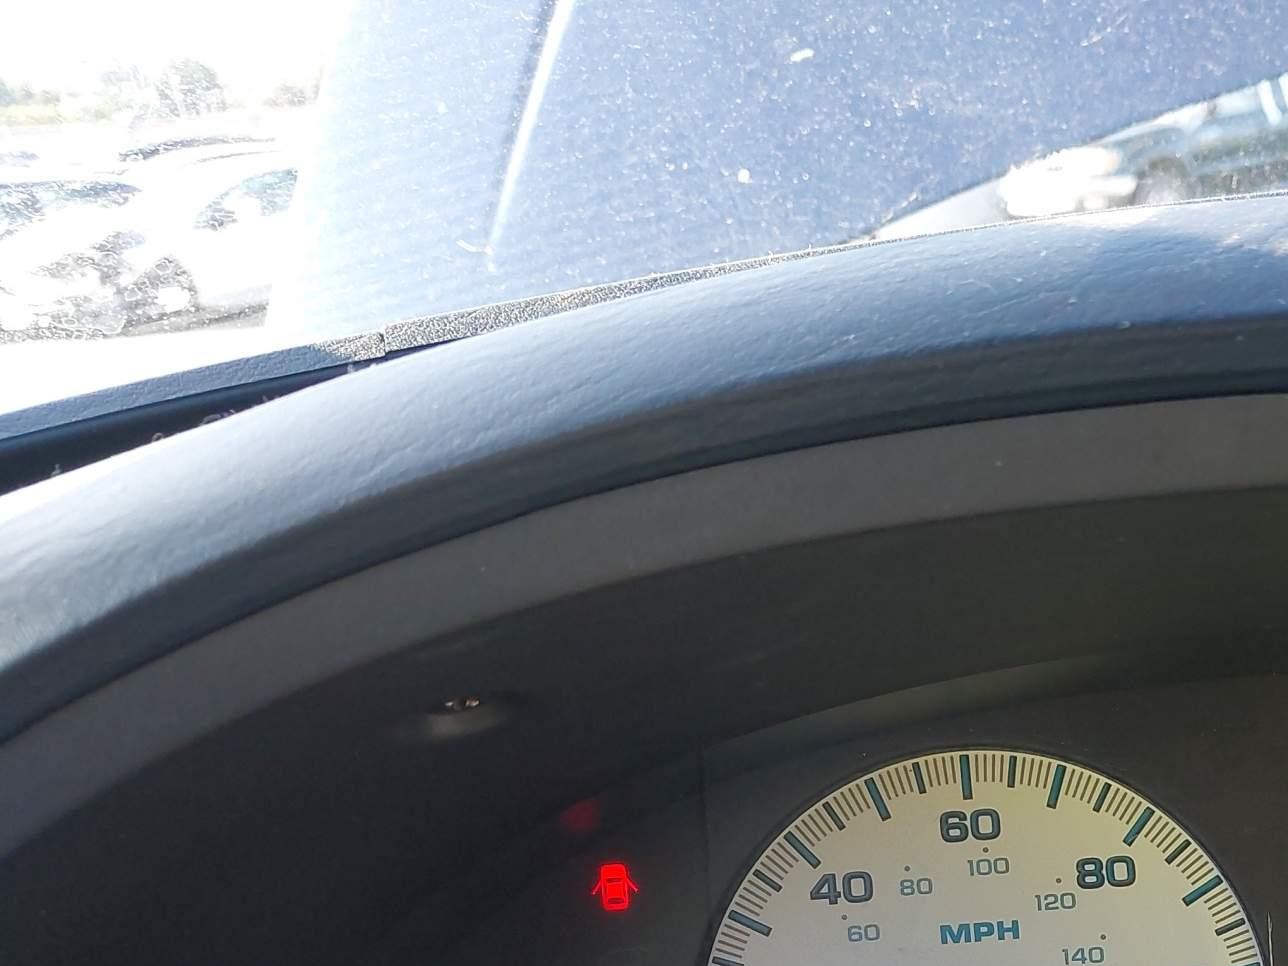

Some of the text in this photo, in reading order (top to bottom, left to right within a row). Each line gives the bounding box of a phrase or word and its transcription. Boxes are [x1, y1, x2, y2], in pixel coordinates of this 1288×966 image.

[939, 809, 1001, 842] 60
[967, 858, 1010, 876] 100
[1076, 856, 1136, 889] 80
[810, 871, 873, 905] 40
[900, 878, 933, 896] 80
[1035, 892, 1077, 911] 120
[848, 924, 880, 941] 60
[940, 920, 1020, 944] MPH
[1062, 946, 1105, 965] 140
